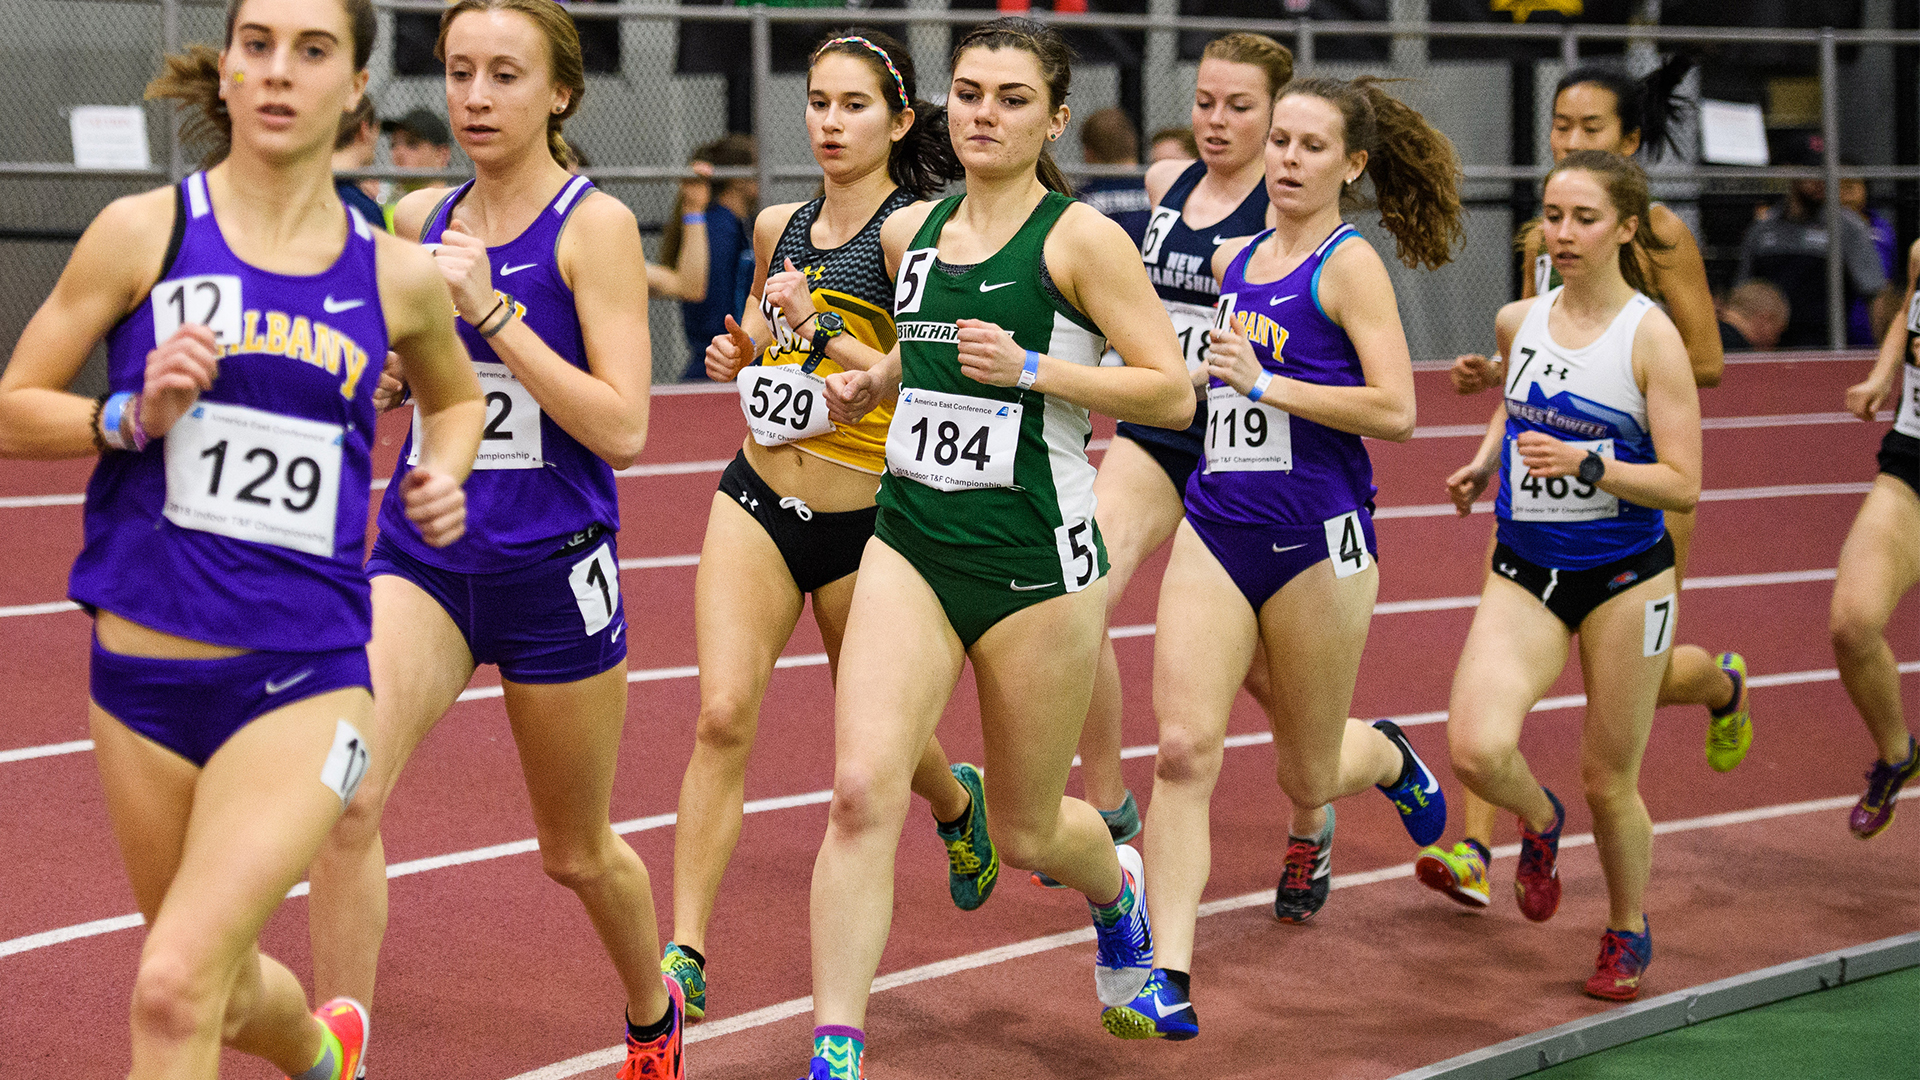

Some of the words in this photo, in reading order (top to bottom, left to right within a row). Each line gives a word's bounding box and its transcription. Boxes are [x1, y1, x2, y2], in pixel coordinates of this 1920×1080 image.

[1144, 212, 1169, 257] 6
[897, 252, 928, 311] 5
[1166, 251, 1204, 273] NEW
[1509, 347, 1536, 394] 7
[750, 377, 814, 430] 529
[914, 397, 938, 407] America
[939, 400, 952, 409] East
[953, 403, 992, 414] Conference
[1210, 407, 1268, 450] 119
[911, 416, 991, 471] 184
[201, 439, 322, 514] 129
[930, 474, 944, 482] T&F
[944, 477, 1002, 488] Championship
[1068, 521, 1093, 586] 5
[1339, 516, 1363, 568] 4
[585, 557, 613, 619] 1
[1653, 600, 1669, 652] 7
